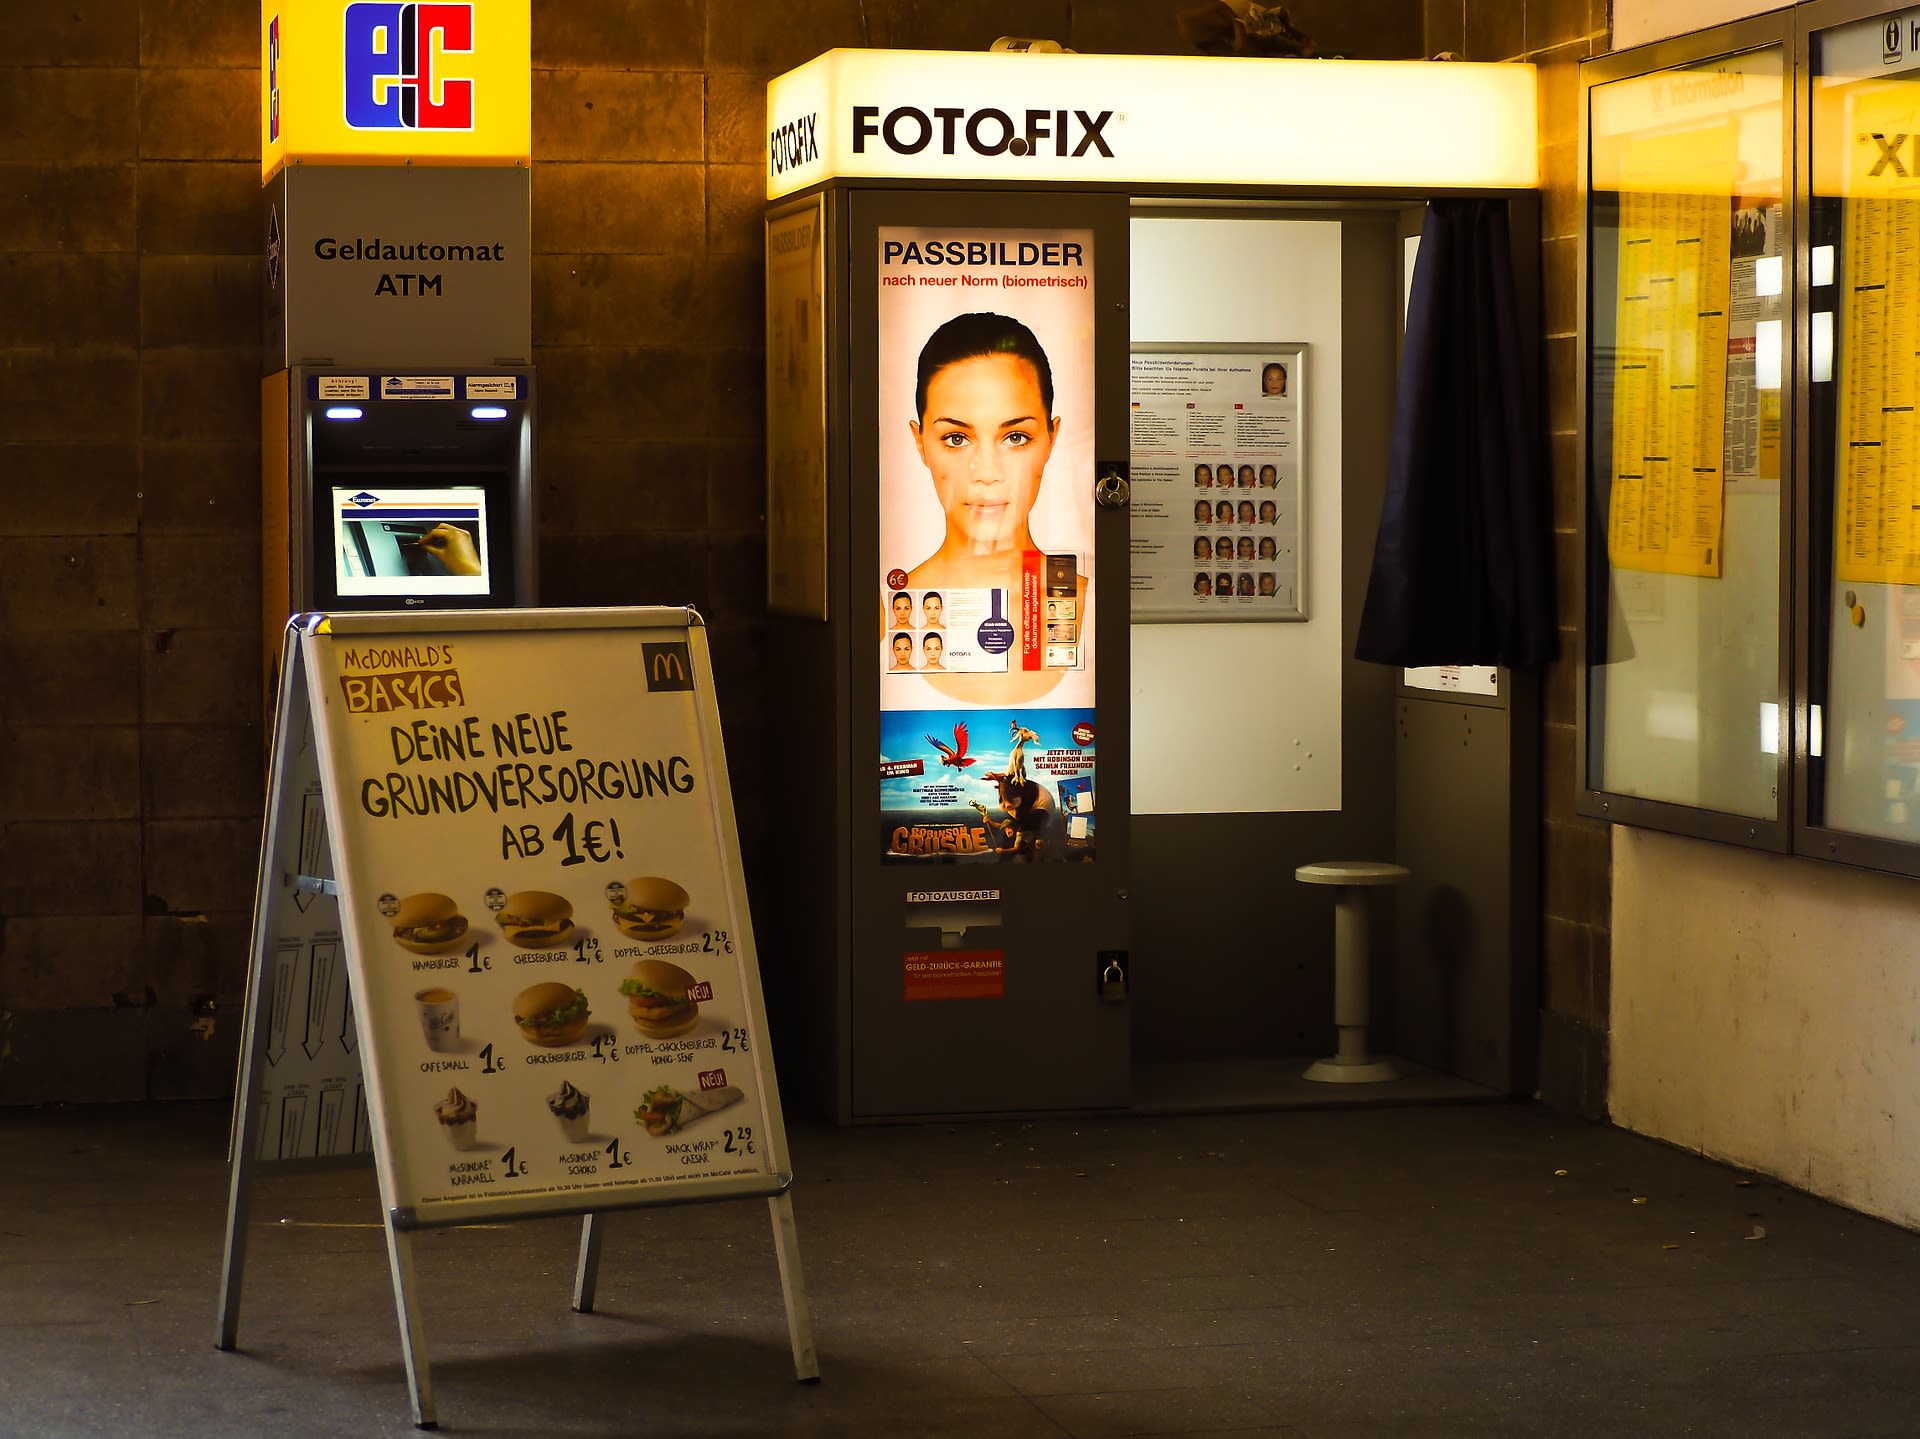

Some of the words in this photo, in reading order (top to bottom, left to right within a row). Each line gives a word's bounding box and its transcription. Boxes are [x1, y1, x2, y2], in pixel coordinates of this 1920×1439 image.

[314, 238, 504, 261] Geldautomat
[883, 241, 1083, 266] PASSBILDER
[375, 274, 442, 296] ATM
[883, 275, 915, 287] nach
[919, 277, 957, 288] neuer
[961, 275, 998, 288] Norm
[1002, 275, 1088, 290] (biometrisch)
[890, 575, 905, 586] 6€
[344, 645, 455, 670] McDONALD'S
[492, 710, 573, 758] NEUE
[361, 756, 695, 819] GRUNDVERSORGUNG
[911, 826, 967, 838] ROBINSON
[501, 824, 545, 860] AB
[893, 827, 989, 854] CRUSOE
[911, 890, 996, 901] FOTOAUSGABE
[614, 943, 700, 958] DOPPEL-CHEESEBURGER
[413, 958, 460, 971] HAMBURGER
[514, 952, 568, 965] CHEESEBURGER
[906, 960, 1002, 971] GELD-ZURÜCK-GARANTIE
[687, 986, 711, 1001] NEU!
[625, 1039, 717, 1056] DOPPEL-CHICKENBURGER
[526, 1051, 587, 1065] CHICKENBURGER
[651, 1053, 695, 1065] HONIG-SENF
[701, 1072, 725, 1088] NEU!
[666, 1143, 691, 1154] SNACK
[681, 1153, 709, 1164] CAESAR
[568, 1166, 597, 1176] SCHOKO
[451, 1174, 496, 1186] KARAMELL
